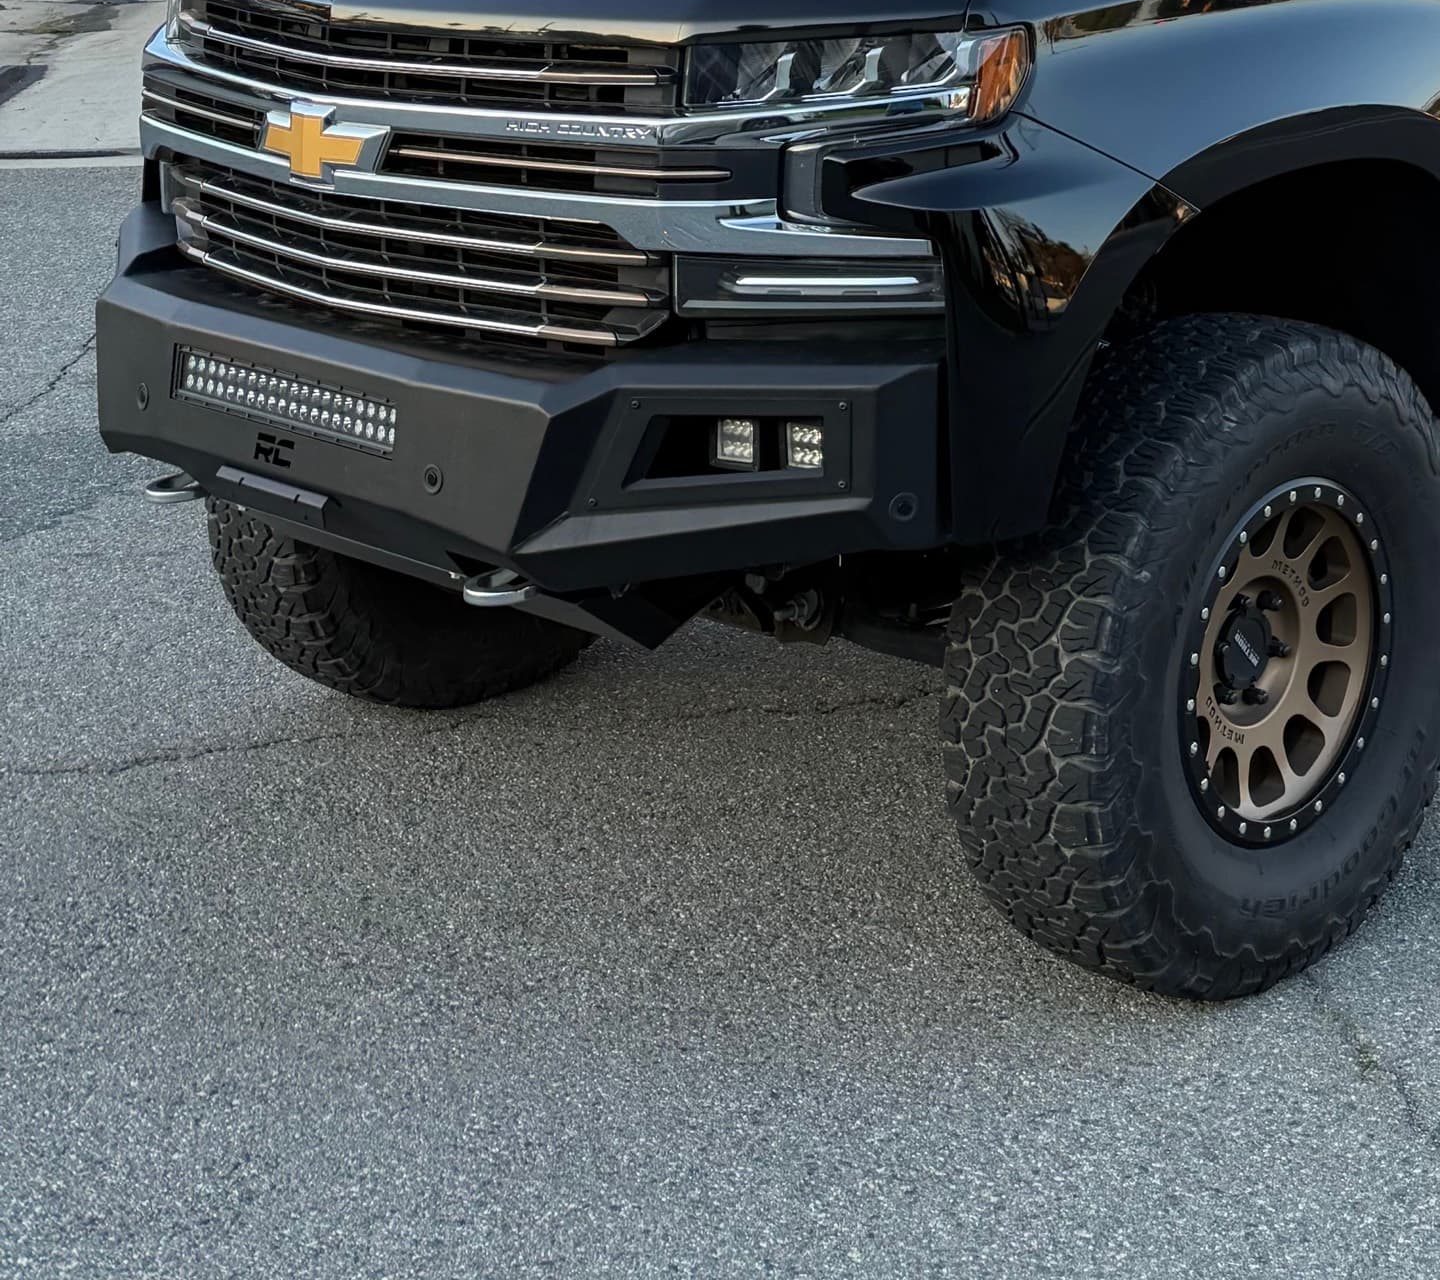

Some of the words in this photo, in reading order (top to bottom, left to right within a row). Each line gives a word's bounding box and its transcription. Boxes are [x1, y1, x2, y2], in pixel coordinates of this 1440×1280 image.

[505, 119, 551, 134] HIGH
[556, 123, 653, 140] COUNTRY
[1271, 559, 1311, 608] METHOD
[1204, 695, 1246, 745] METHOD
